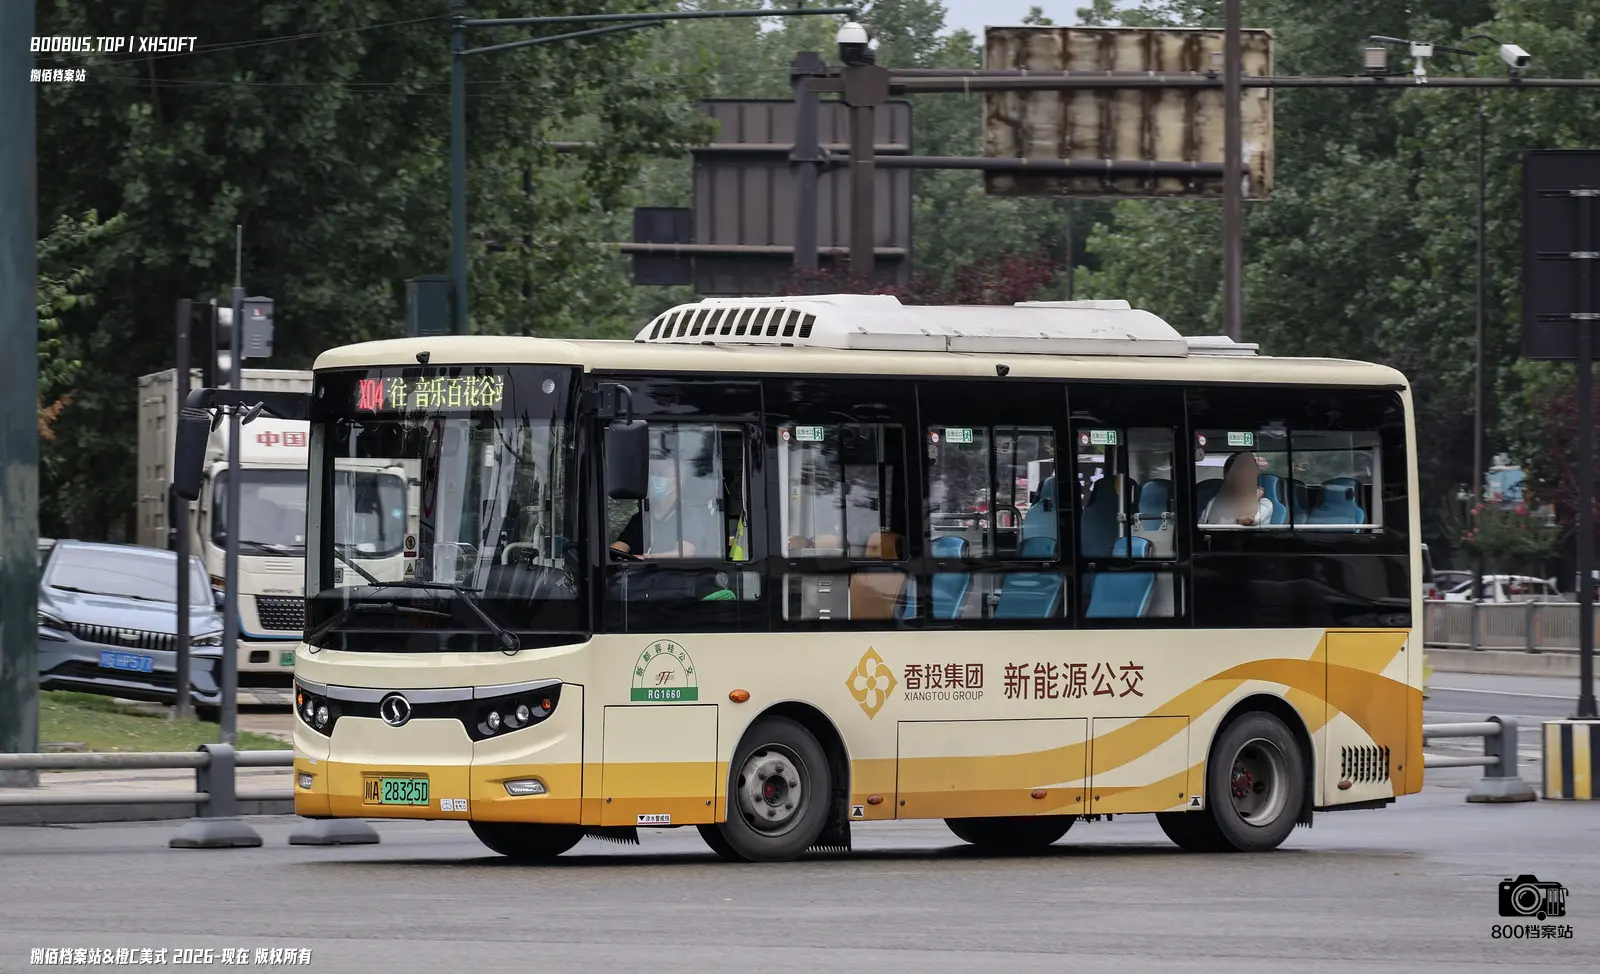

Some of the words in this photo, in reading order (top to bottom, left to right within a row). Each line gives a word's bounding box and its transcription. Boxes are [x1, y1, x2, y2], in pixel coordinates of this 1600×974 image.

[358, 379, 384, 410] X04
[387, 377, 408, 409] 往
[256, 431, 307, 447] 中国
[904, 663, 984, 690] 香投集团
[1003, 661, 1145, 700] 新能源公交
[648, 689, 681, 699] RG1660
[904, 690, 951, 701] XIANGTOU
[952, 690, 984, 700] GROUP
